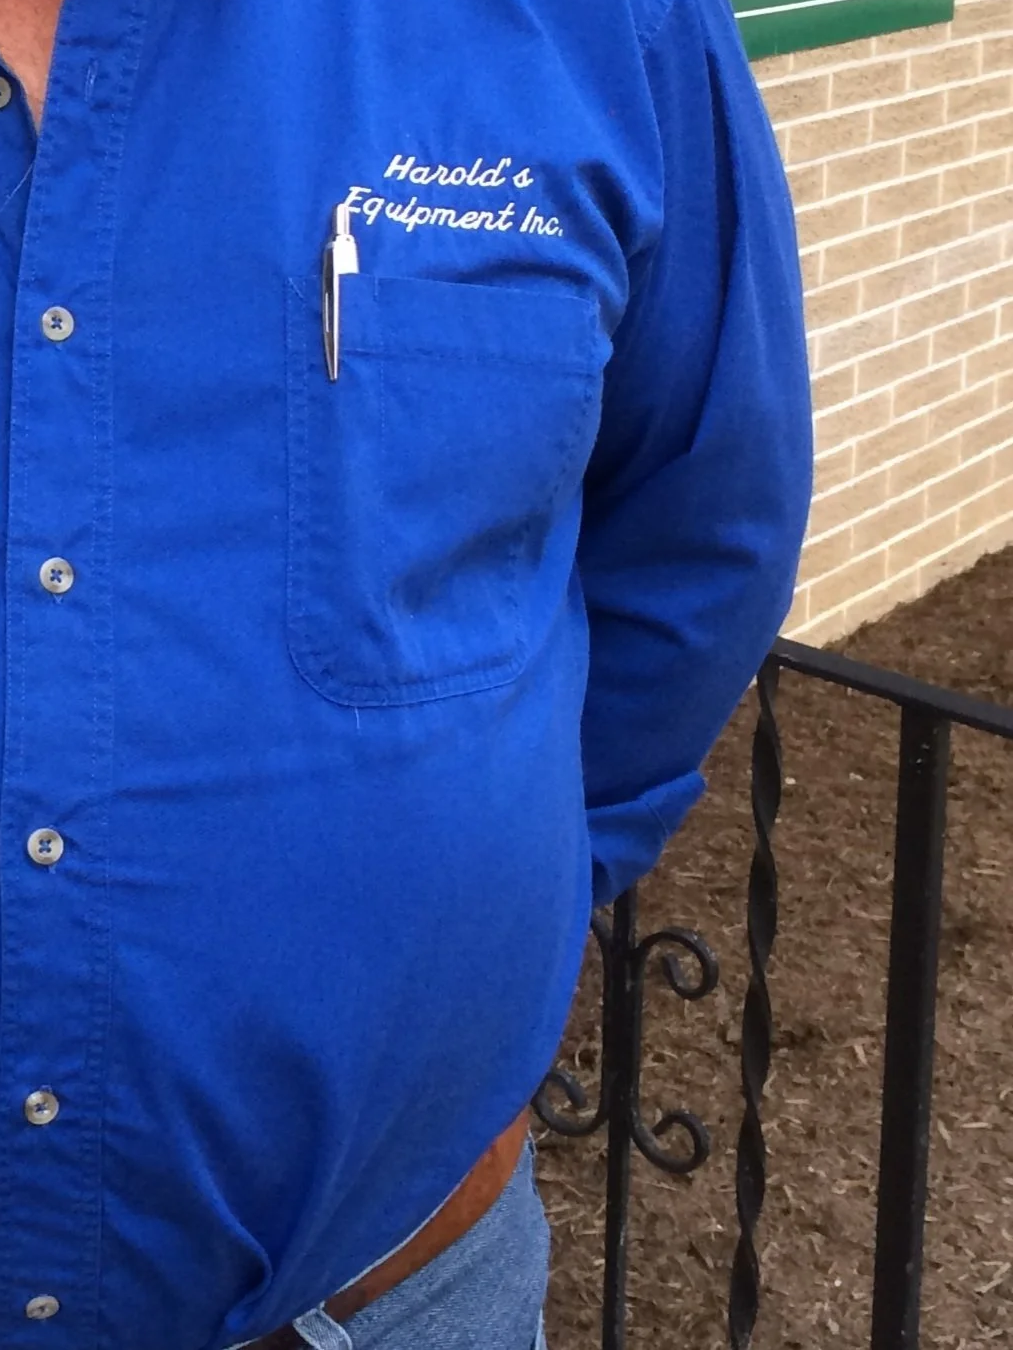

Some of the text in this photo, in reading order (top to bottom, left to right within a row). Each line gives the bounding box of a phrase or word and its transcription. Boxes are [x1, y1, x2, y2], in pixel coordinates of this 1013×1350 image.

[383, 153, 534, 188] Harold's
[343, 185, 564, 237] Equipment Inc.
